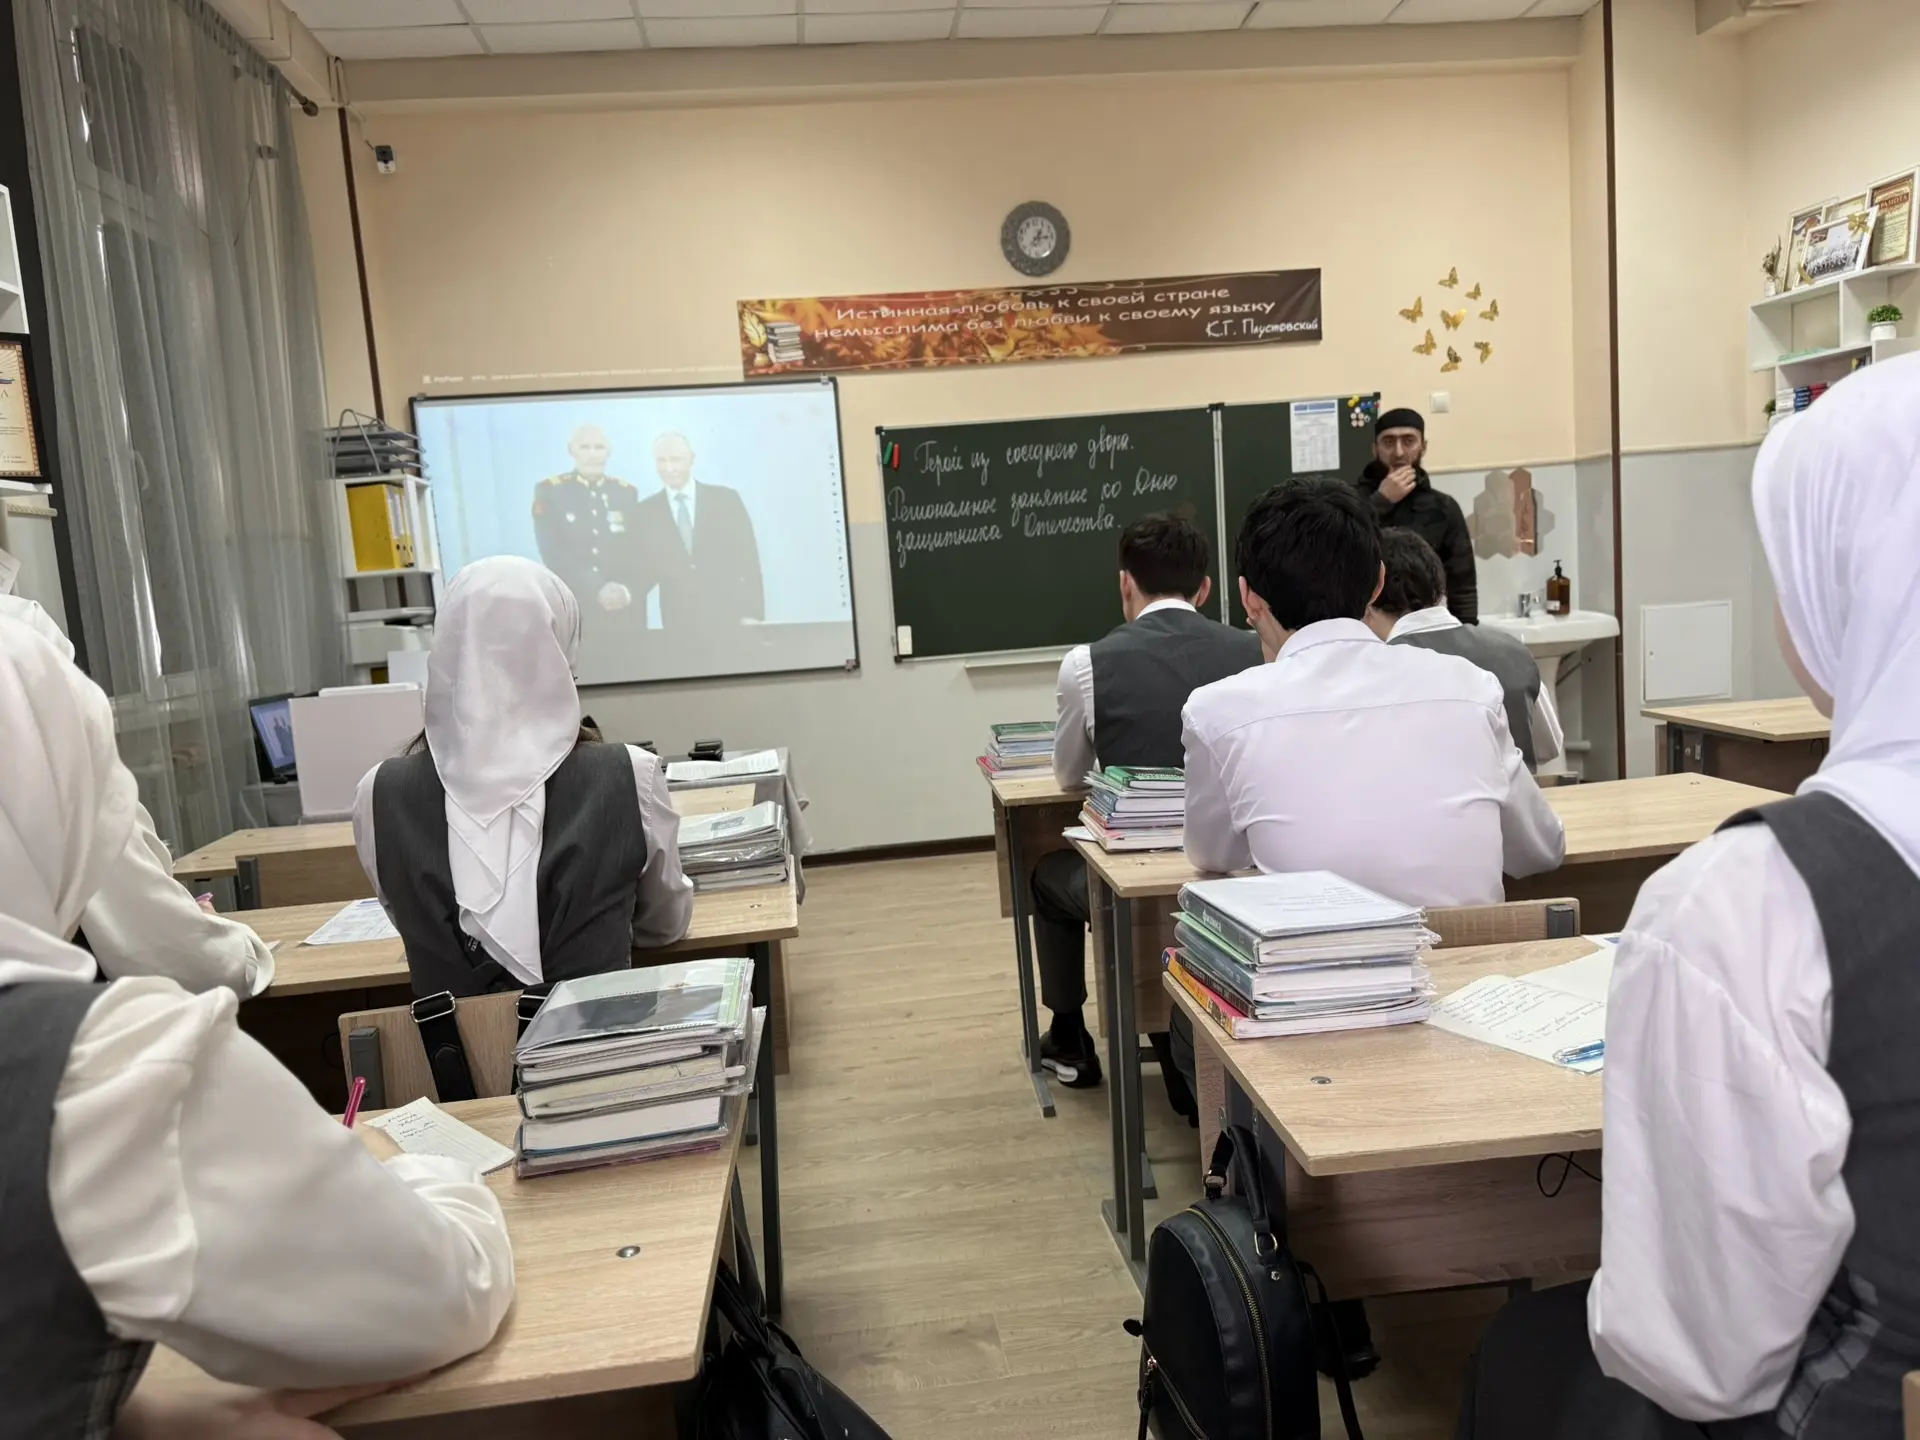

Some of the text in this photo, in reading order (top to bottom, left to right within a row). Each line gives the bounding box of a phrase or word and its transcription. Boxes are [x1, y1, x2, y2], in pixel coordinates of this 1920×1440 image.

[814, 302, 1276, 339] немыслима без любви к своему языку
[836, 287, 1231, 321] Истинная любовь к своей стране
[1242, 317, 1319, 338] Паустовский
[914, 424, 1134, 486] Герой из соседнего двора.
[887, 466, 1178, 528] Региональное занятие ко Дню
[896, 503, 1122, 568] защитника Отечества.
